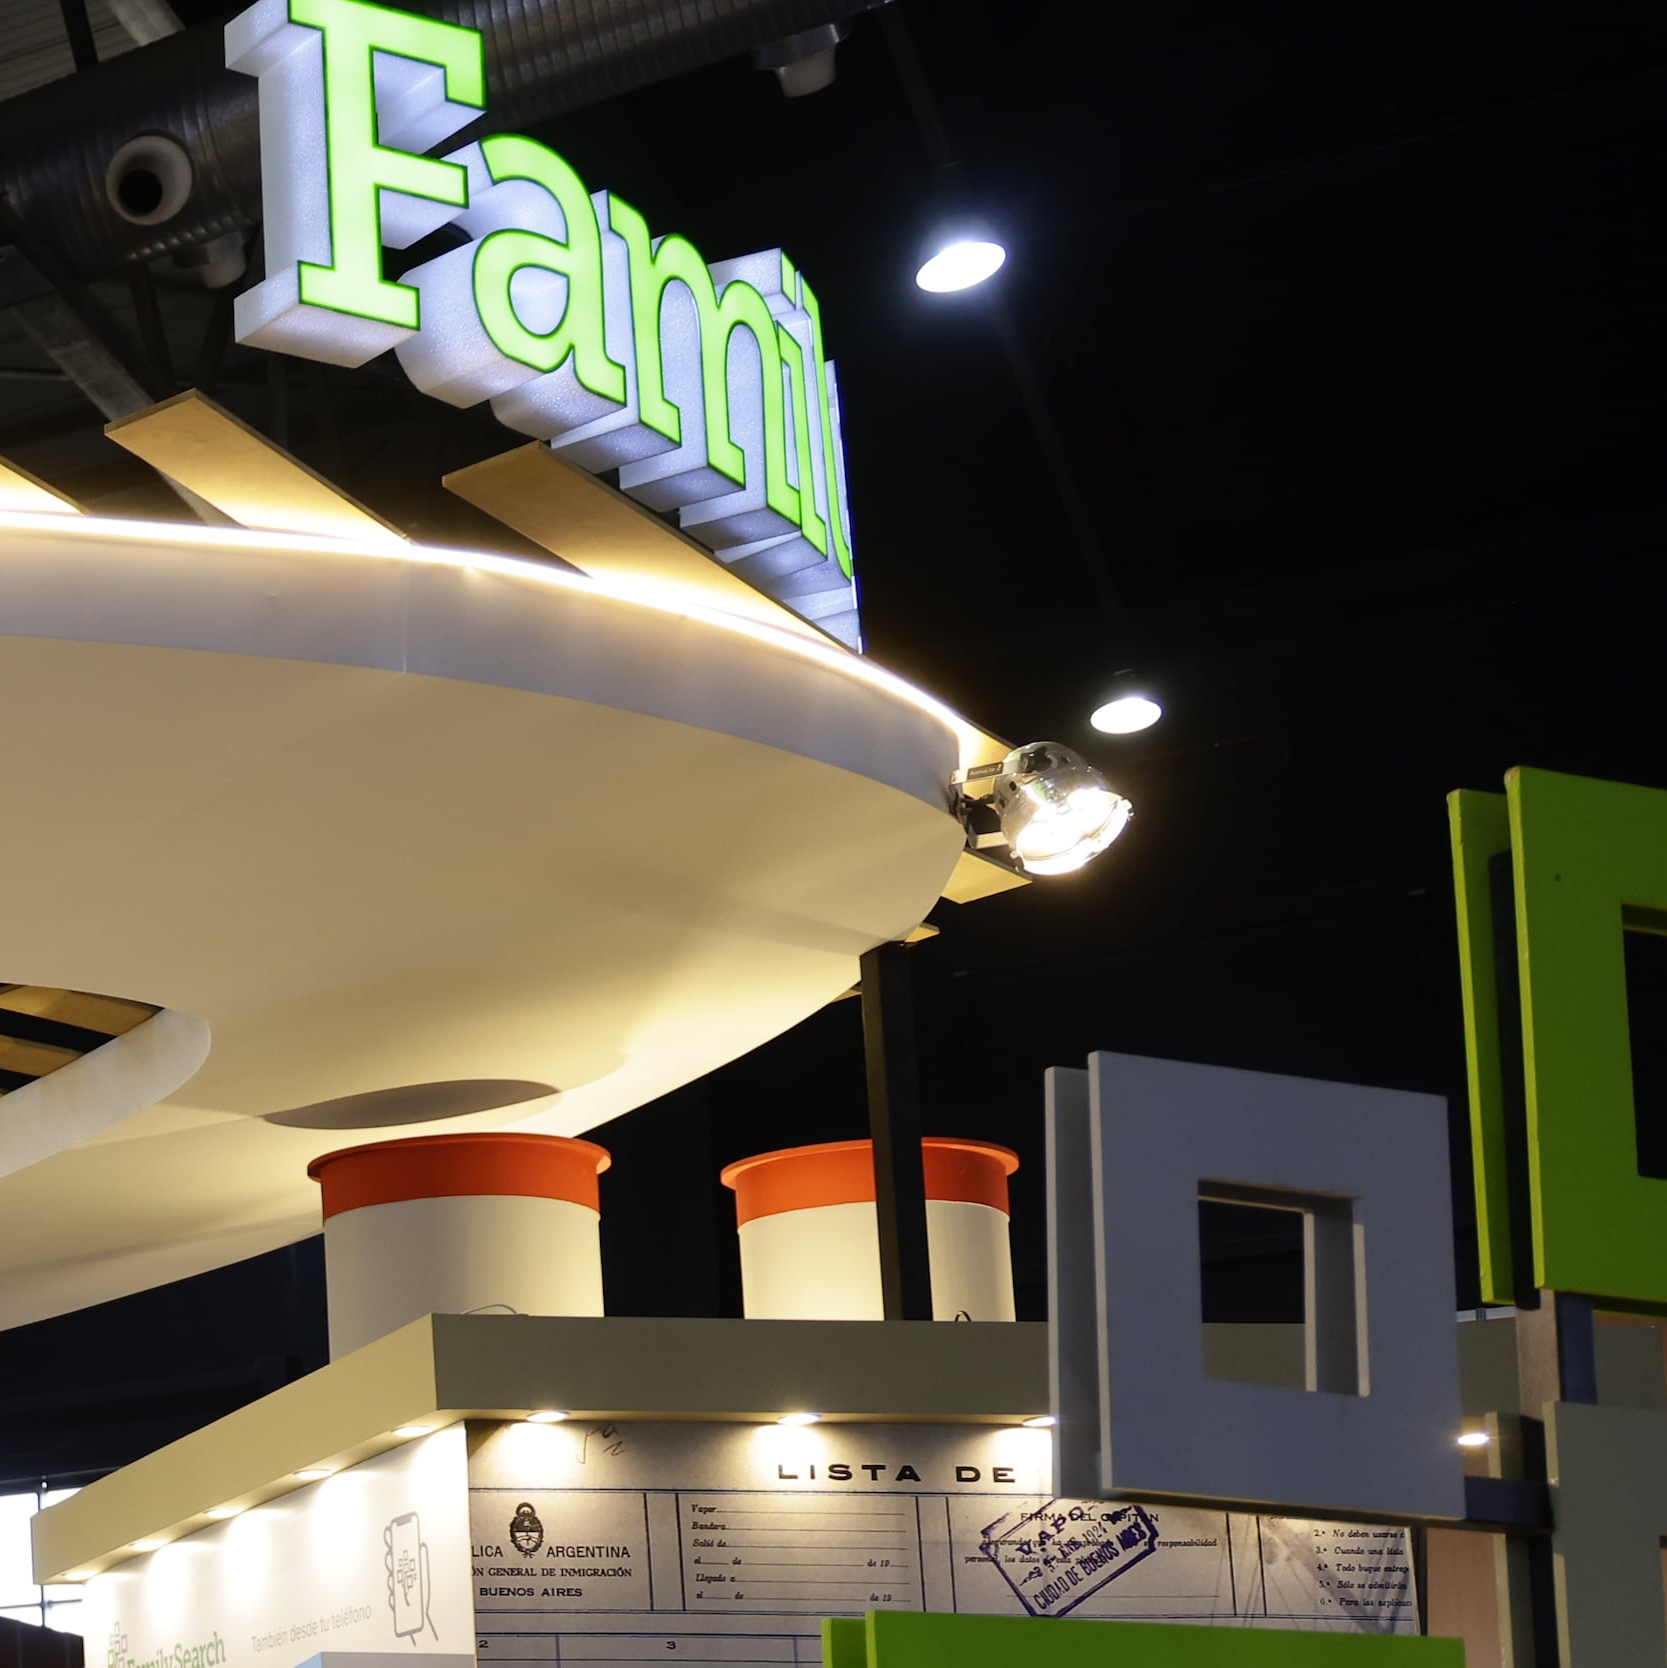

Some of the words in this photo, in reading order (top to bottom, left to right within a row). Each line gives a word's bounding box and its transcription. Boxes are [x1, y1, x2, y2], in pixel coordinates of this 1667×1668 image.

[778, 1464, 922, 1482] LISTA
[955, 1466, 1016, 1483] DE
[545, 1546, 631, 1558] ARGENTINA
[488, 1567, 537, 1577] GENERAL
[541, 1568, 556, 1577] DE
[560, 1567, 632, 1577] INMIGRACIÓN
[479, 1587, 535, 1596] BUENOS
[541, 1588, 583, 1597] AIRES
[331, 1602, 372, 1631] teléfono
[478, 1640, 489, 1649] 2
[665, 1641, 677, 1650] 3
